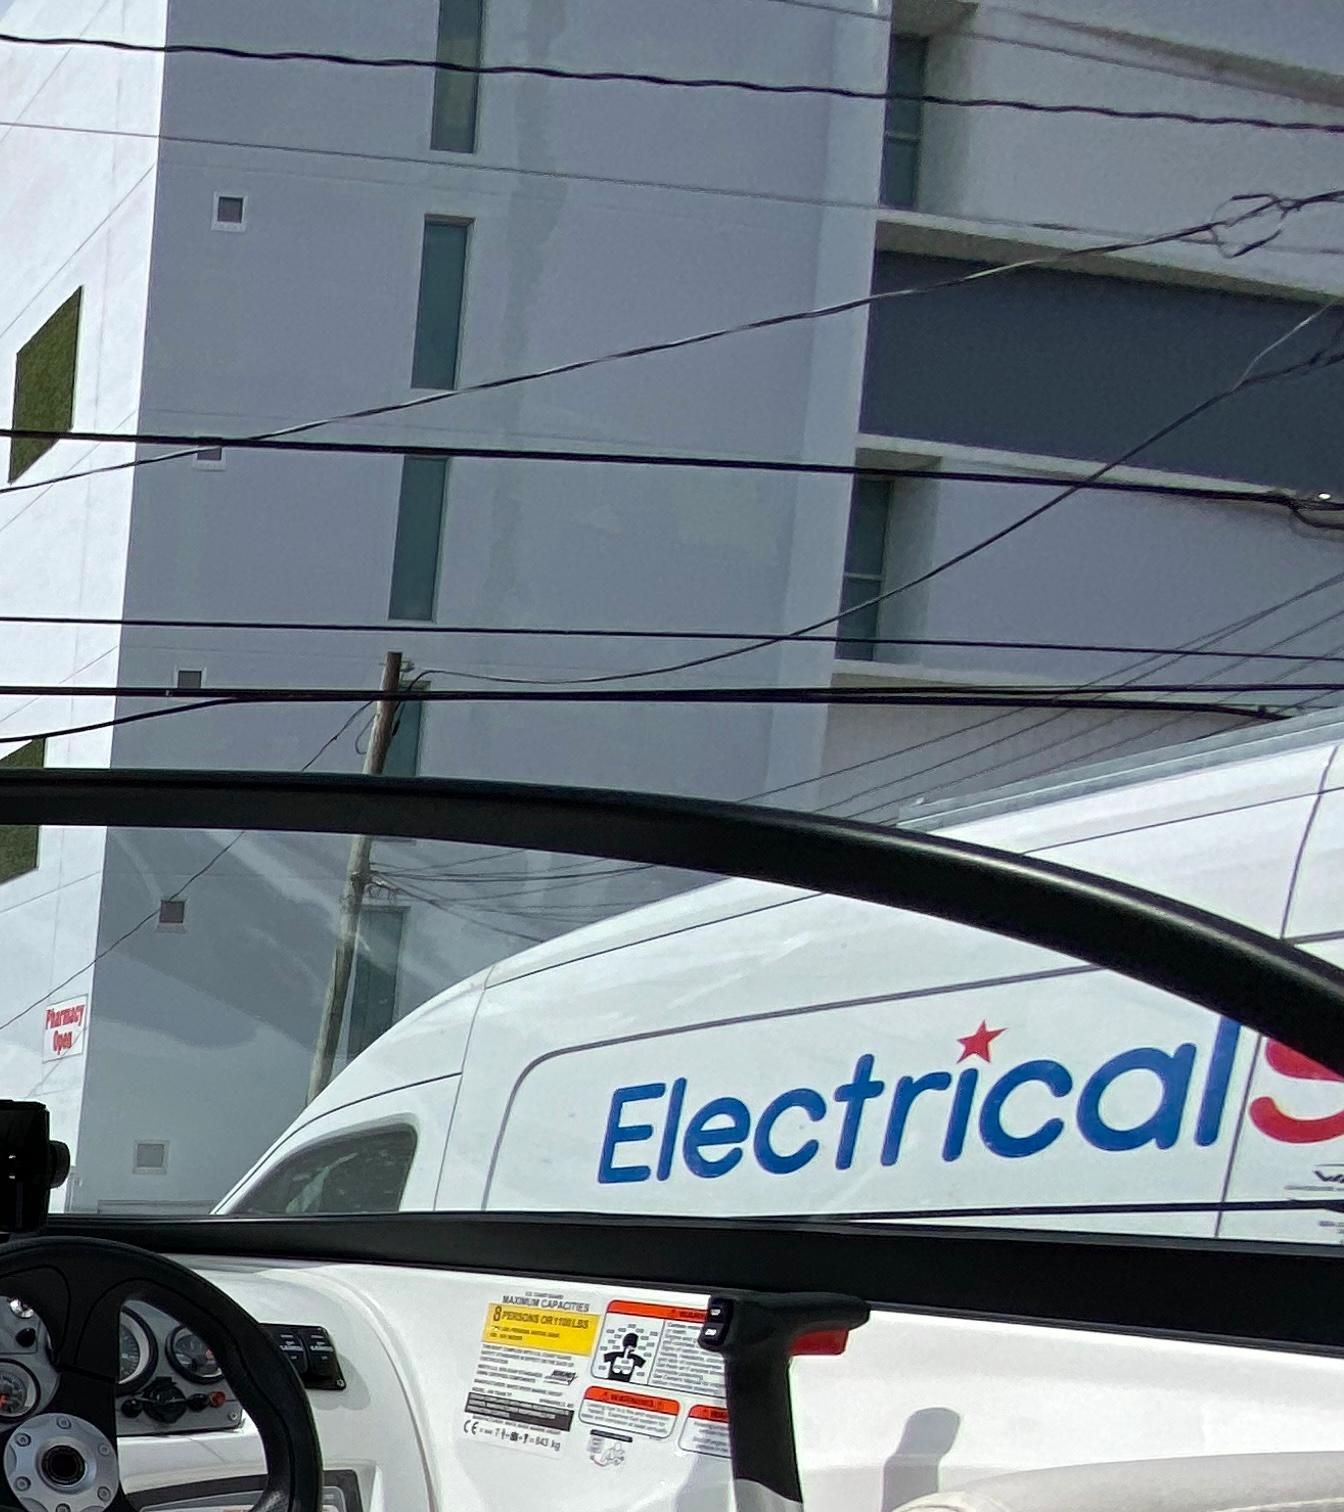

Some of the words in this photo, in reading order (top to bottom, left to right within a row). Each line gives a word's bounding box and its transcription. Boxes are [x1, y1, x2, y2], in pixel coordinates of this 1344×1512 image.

[45, 1004, 86, 1030] Pharmacy
[53, 1030, 73, 1056] Open
[502, 1295, 540, 1308] MAXIMUM
[540, 1299, 591, 1312] CAPACITIES
[501, 1310, 540, 1324] PERSONS
